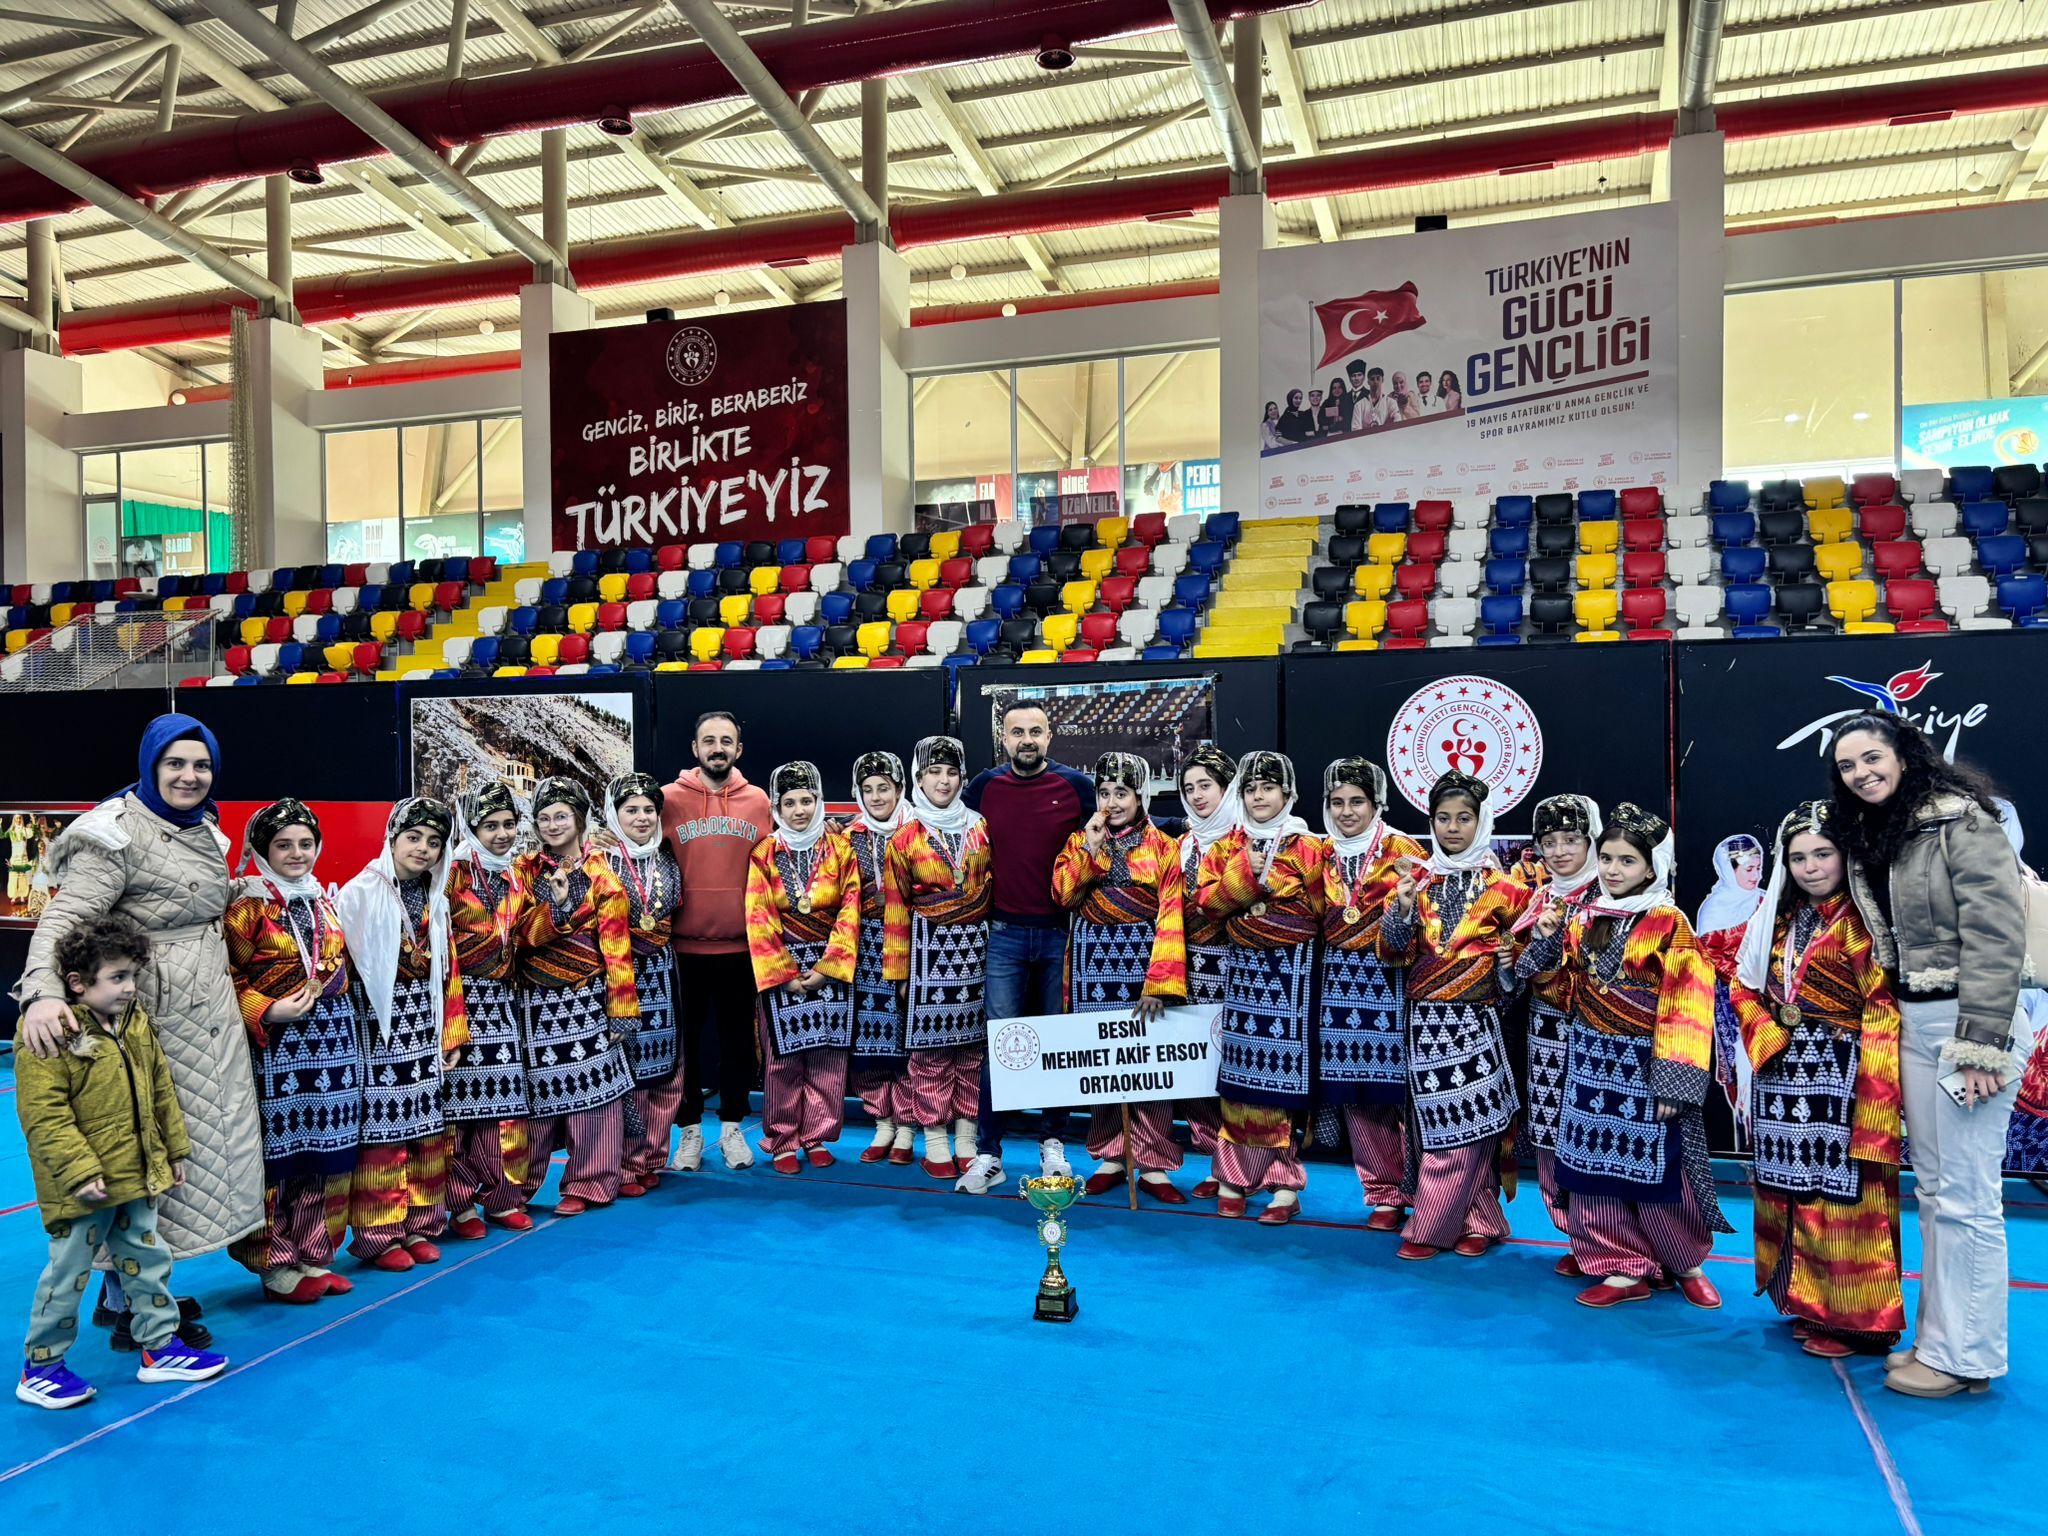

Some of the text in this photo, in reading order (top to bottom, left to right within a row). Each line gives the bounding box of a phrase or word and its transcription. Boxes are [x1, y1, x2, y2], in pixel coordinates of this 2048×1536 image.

[1485, 237, 1630, 296] TÜRKİYE'NİN
[1502, 275, 1613, 341] GÜCÜ
[1467, 316, 1650, 397] GENÇLİĞİ
[582, 376, 808, 442] GENCİZ, BİRİZ, BERABERİZ
[1466, 419, 1476, 429] 19
[1479, 412, 1508, 426] MAYIS
[1565, 396, 1592, 409] ANMA
[1594, 386, 1634, 403] GENÇLİK
[1638, 384, 1649, 394] VE
[1480, 401, 1636, 440] SPOR BAYRAMIMIZ KUTLU OLSUN!
[629, 425, 752, 477] BİRLİKTE
[565, 456, 831, 551] TÜRKİYE'YİZ
[1416, 705, 1449, 764] CUMHURİYETİ
[1449, 703, 1491, 718] GENÇLİK
[1490, 714, 1503, 727] VE
[1498, 724, 1513, 750] SPOR
[675, 815, 758, 845] BROOKLYN
[1041, 1041, 1209, 1071] MEHMET AKİF ERSOY
[1079, 1070, 1174, 1095] ORTAOKULU
